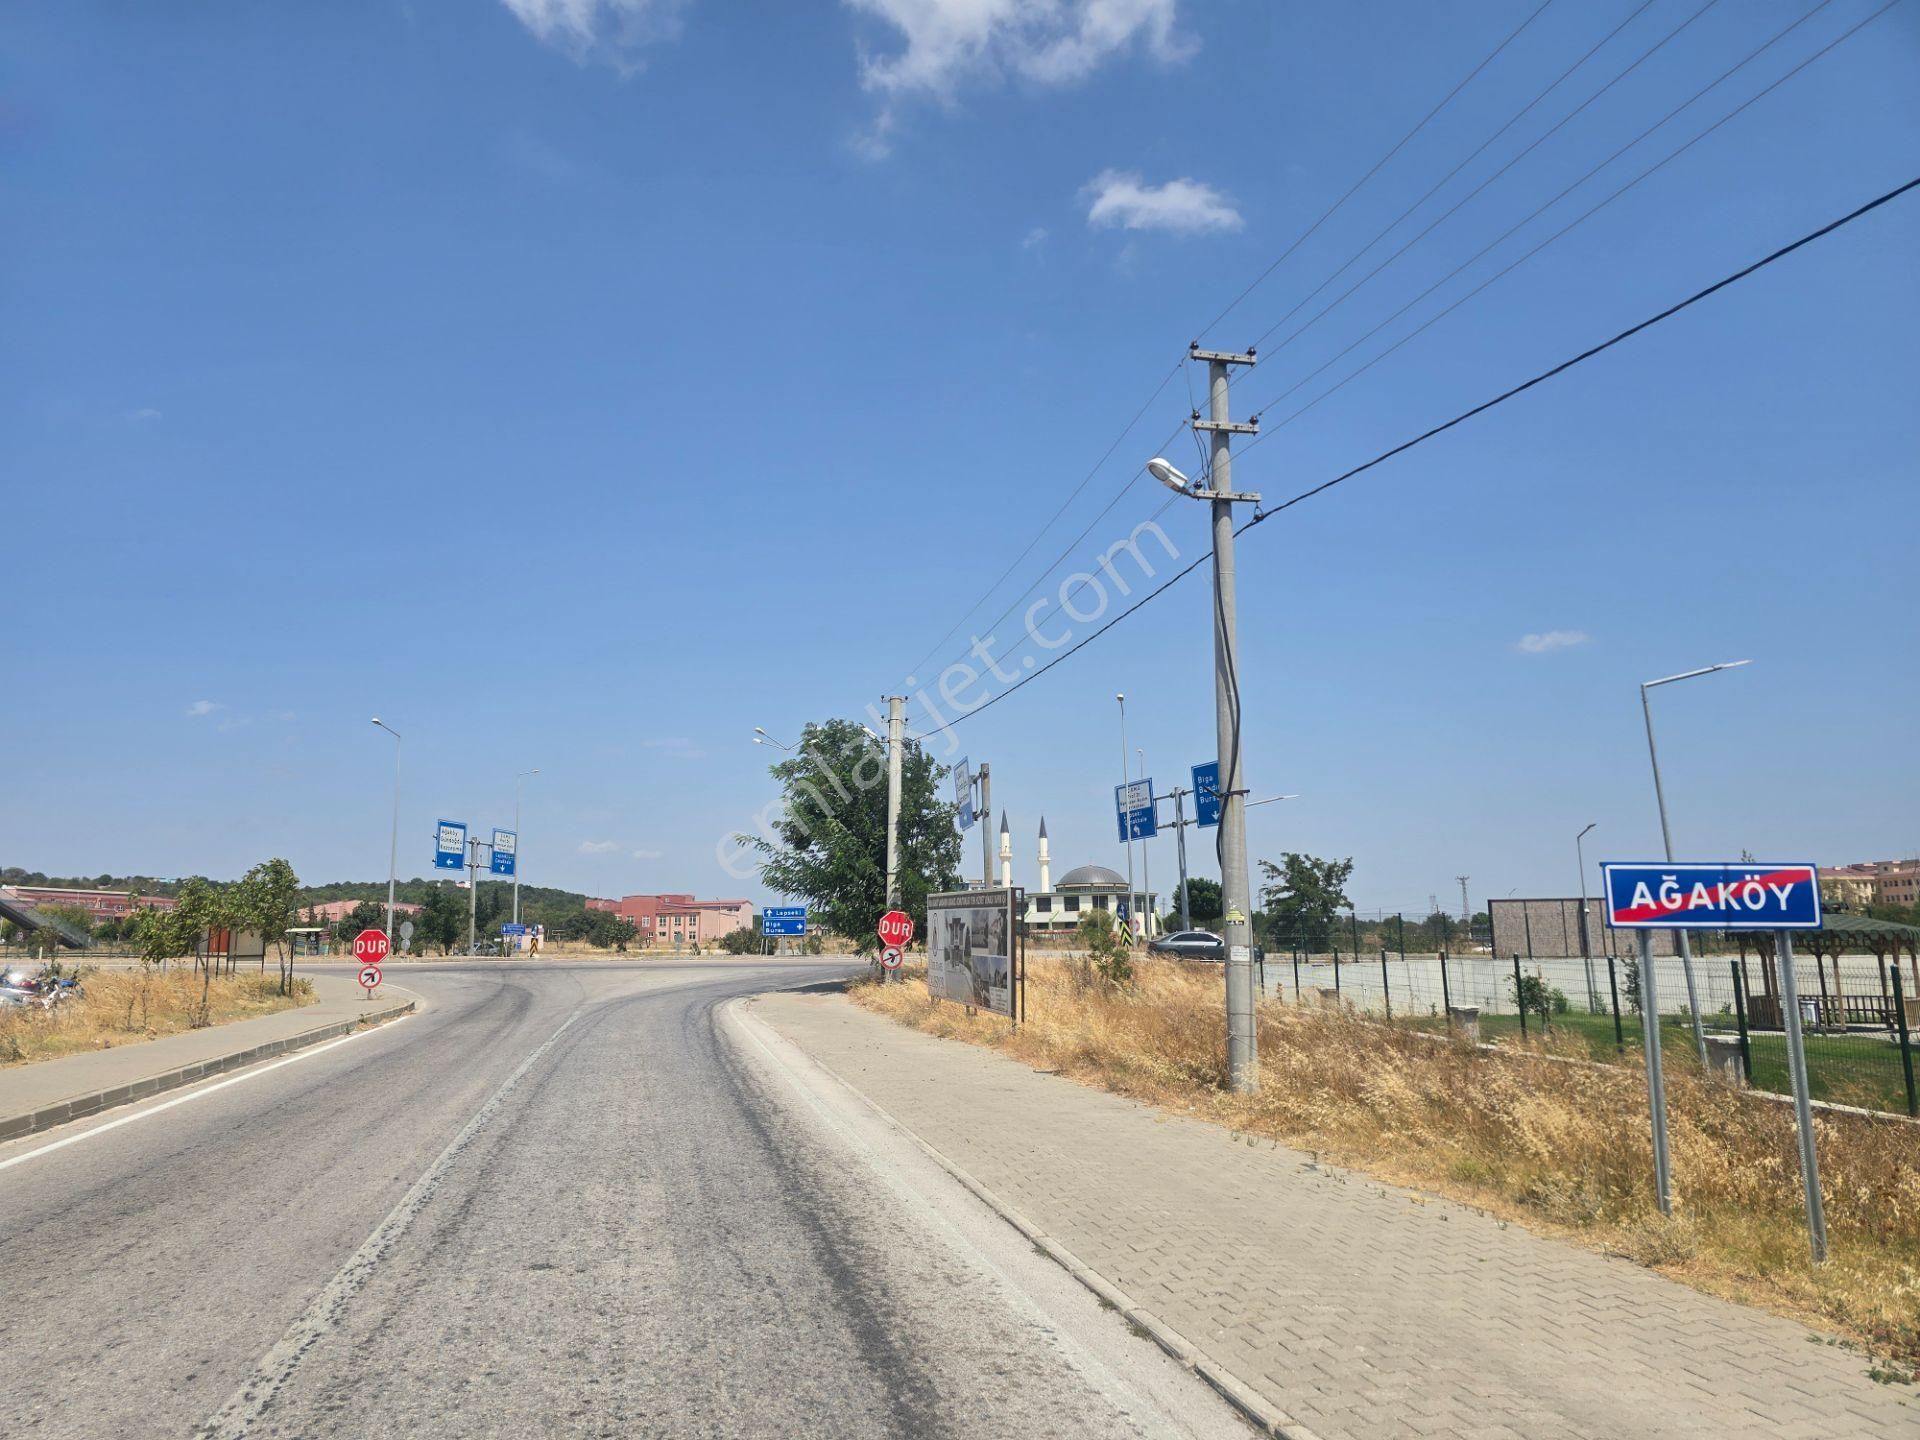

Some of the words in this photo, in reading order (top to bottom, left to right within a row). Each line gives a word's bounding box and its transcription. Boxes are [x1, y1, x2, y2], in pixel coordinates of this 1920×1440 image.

[1197, 775, 1213, 784] Biga
[1630, 874, 1795, 911] AĞAKÖY
[881, 920, 910, 937] DUR
[356, 940, 387, 954] DUR
